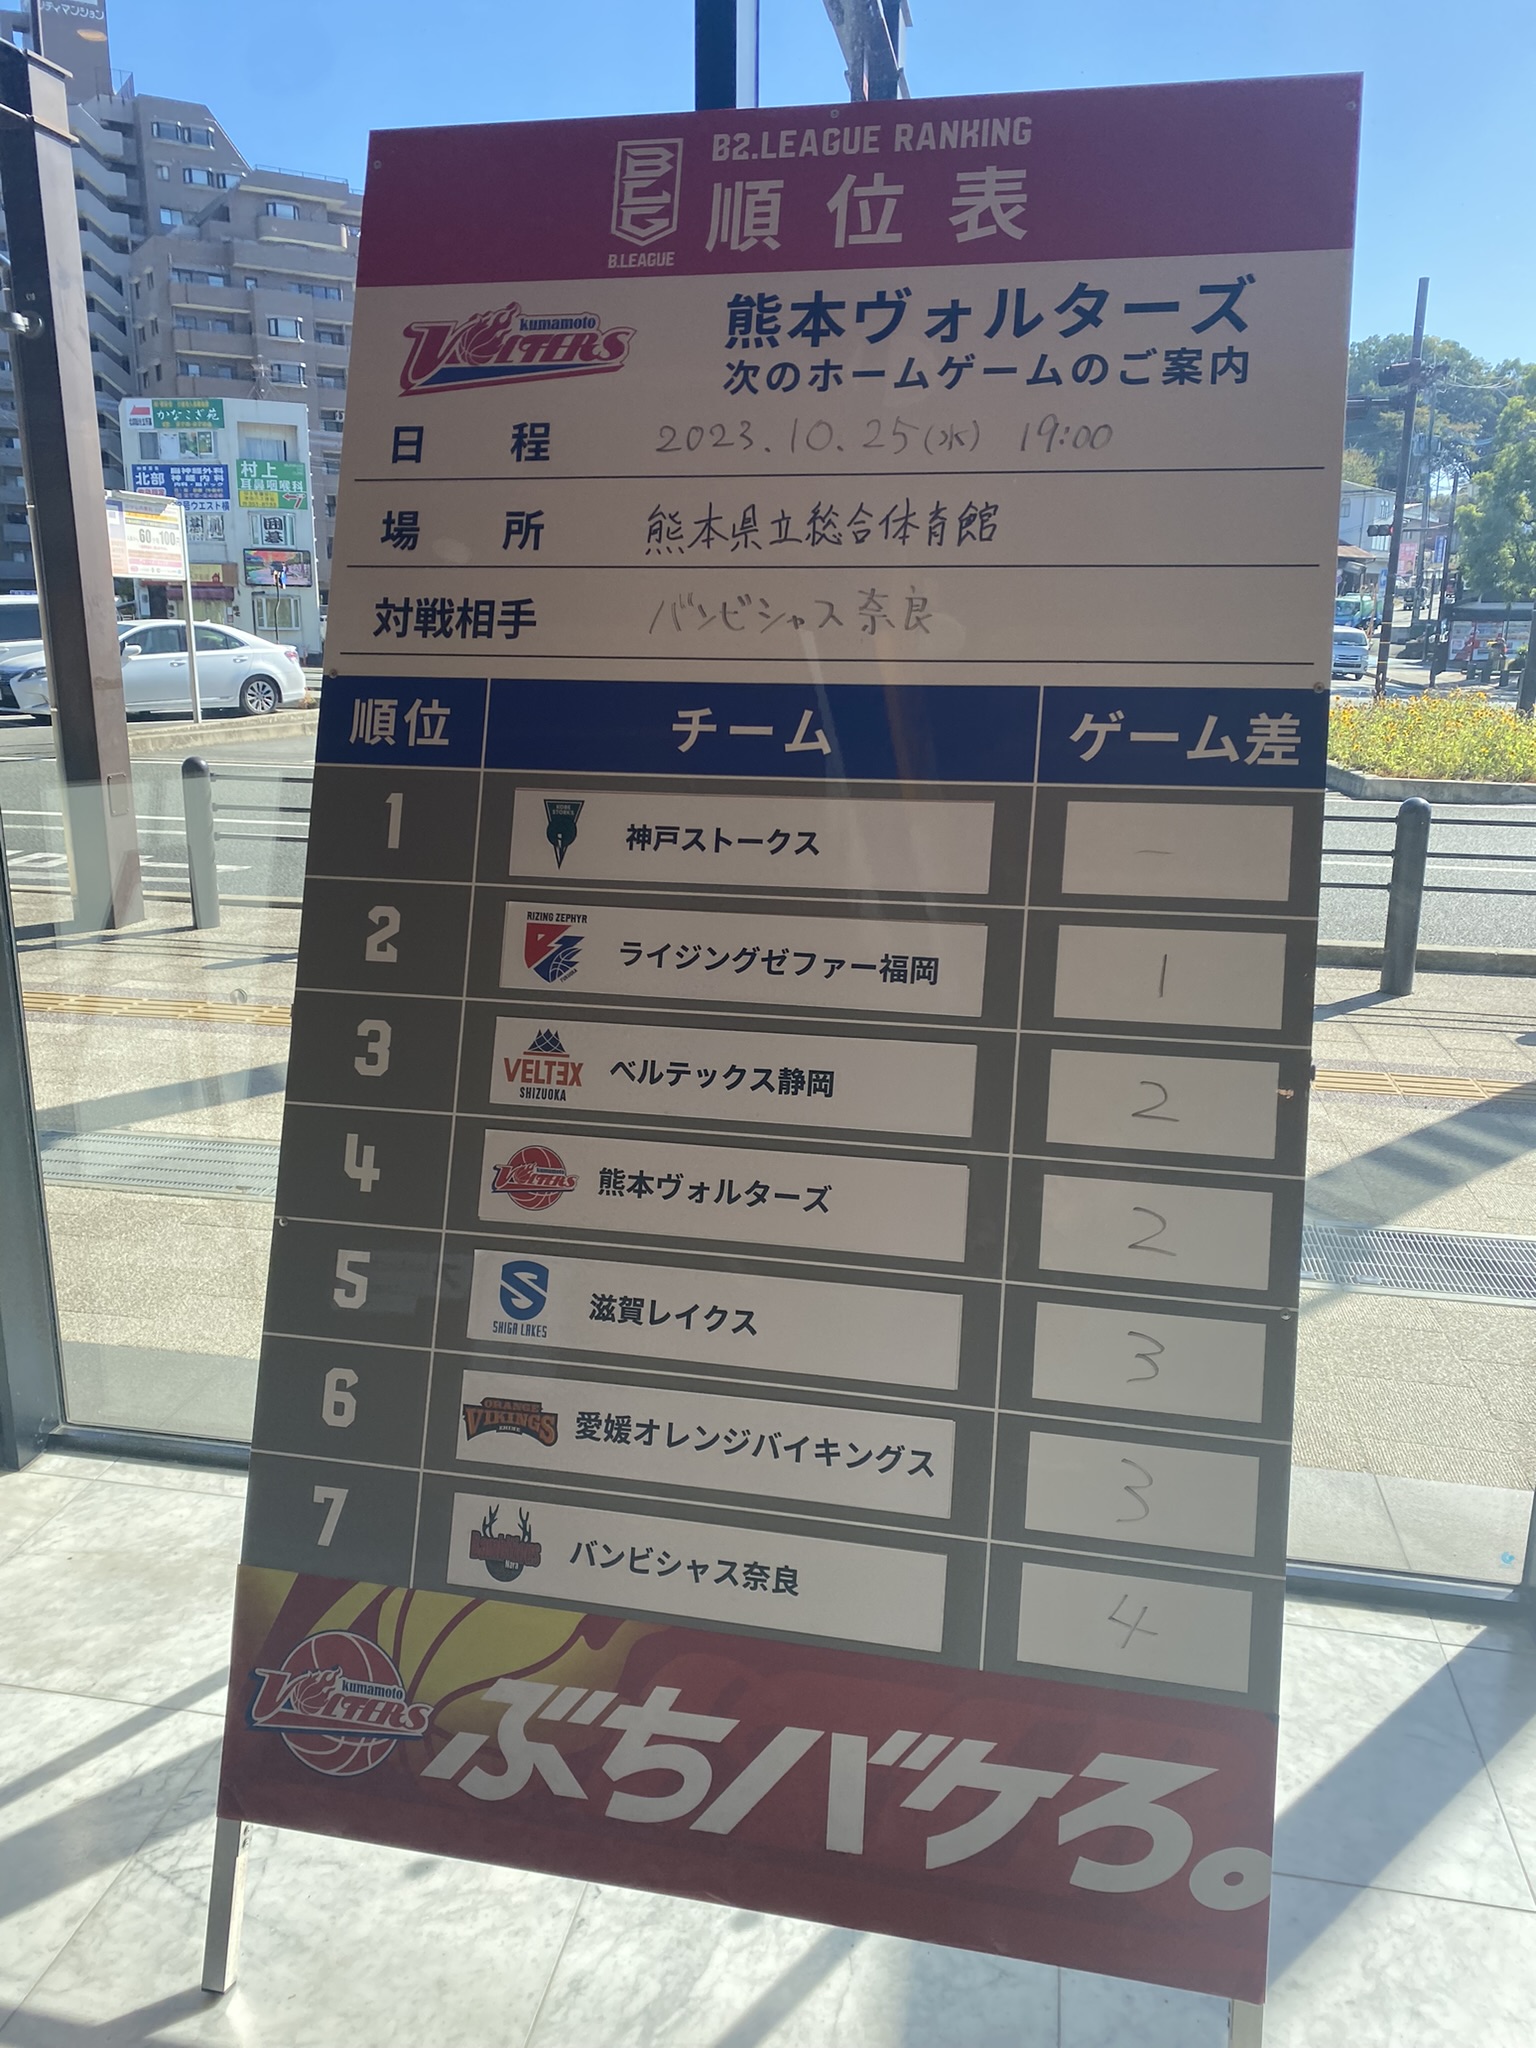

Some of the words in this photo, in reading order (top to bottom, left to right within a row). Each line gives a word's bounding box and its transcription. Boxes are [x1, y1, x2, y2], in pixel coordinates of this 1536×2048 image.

[712, 125, 881, 162] B2.LEAGUE
[894, 117, 1032, 152] RANKING
[705, 165, 1029, 252] 順位表
[608, 252, 675, 268] B.LEAGUE
[519, 316, 597, 331] kumamoto
[724, 274, 1257, 350] 熊本ヴォルターズ
[722, 346, 1250, 395] 次のホームゲームのご案内
[1020, 417, 1113, 452] 19:00
[135, 472, 165, 486] 北部
[240, 460, 278, 478] 村上
[139, 529, 152, 543] 60
[159, 530, 176, 546] 100
[645, 498, 999, 555] 熊本県立総合体育館
[373, 597, 537, 640] 対戦相手
[649, 585, 933, 636] バンビシャス奈良
[349, 698, 450, 747] 順位
[672, 707, 831, 756] チーム
[1069, 710, 1301, 766] ゲーム差
[386, 792, 404, 849] 1
[625, 823, 820, 855] 神戸ストークス
[365, 906, 401, 963] 2
[527, 911, 554, 922] RIZING
[555, 913, 588, 923] ZEPHYR
[619, 941, 940, 986] ライジングゼファー福岡
[1158, 953, 1168, 998] 1
[354, 1018, 392, 1077] 3
[520, 1087, 566, 1101] SHIZUOKA
[609, 1059, 835, 1098] ベルテックス静岡
[1131, 1080, 1180, 1122] 2
[343, 1133, 380, 1193] 4
[598, 1167, 832, 1214] 熊本ヴォルターズ
[1128, 1206, 1177, 1257] 2
[333, 1249, 371, 1309] 5
[493, 1321, 518, 1335] SHIGA
[521, 1323, 548, 1338] LAKES
[589, 1293, 757, 1337] 滋賀レイクス
[1127, 1330, 1165, 1383] 3
[322, 1367, 359, 1428] 6
[484, 1399, 540, 1412] ORANGE
[465, 1408, 556, 1445] VIKINGS
[575, 1410, 935, 1478] 愛媛オレンジバイキングス
[1116, 1458, 1153, 1522] 3
[313, 1485, 349, 1547] 7
[505, 1560, 519, 1570] Nara
[570, 1539, 800, 1598] バンビシャス奈良
[1109, 1594, 1158, 1649] 4
[342, 1680, 403, 1699] kumamoto
[421, 1678, 1273, 1911] ぶちバケろ。
